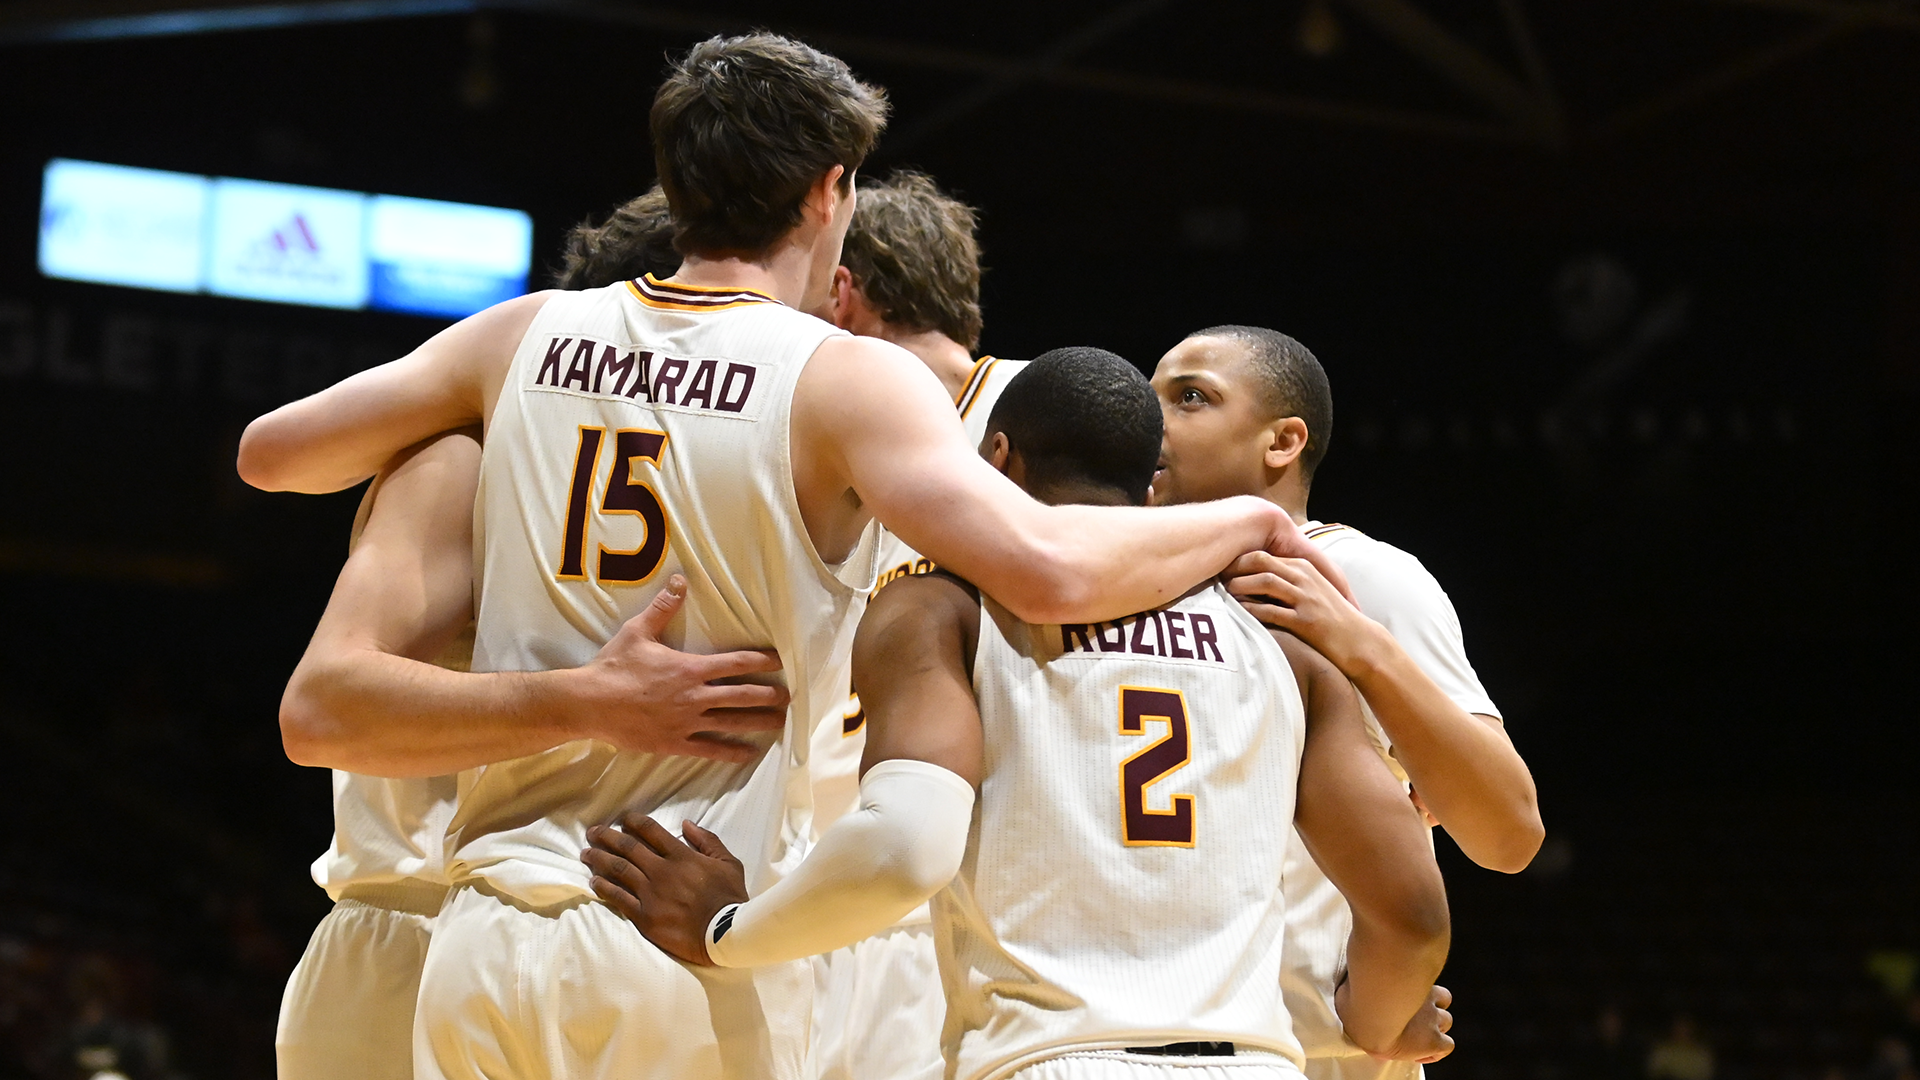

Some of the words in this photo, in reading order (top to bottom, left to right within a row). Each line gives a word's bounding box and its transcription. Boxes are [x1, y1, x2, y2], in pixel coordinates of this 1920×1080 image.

[535, 337, 757, 413] KAMARAD
[556, 424, 669, 585] 15
[1061, 610, 1225, 663] ROZIER
[1119, 685, 1196, 848] 2
